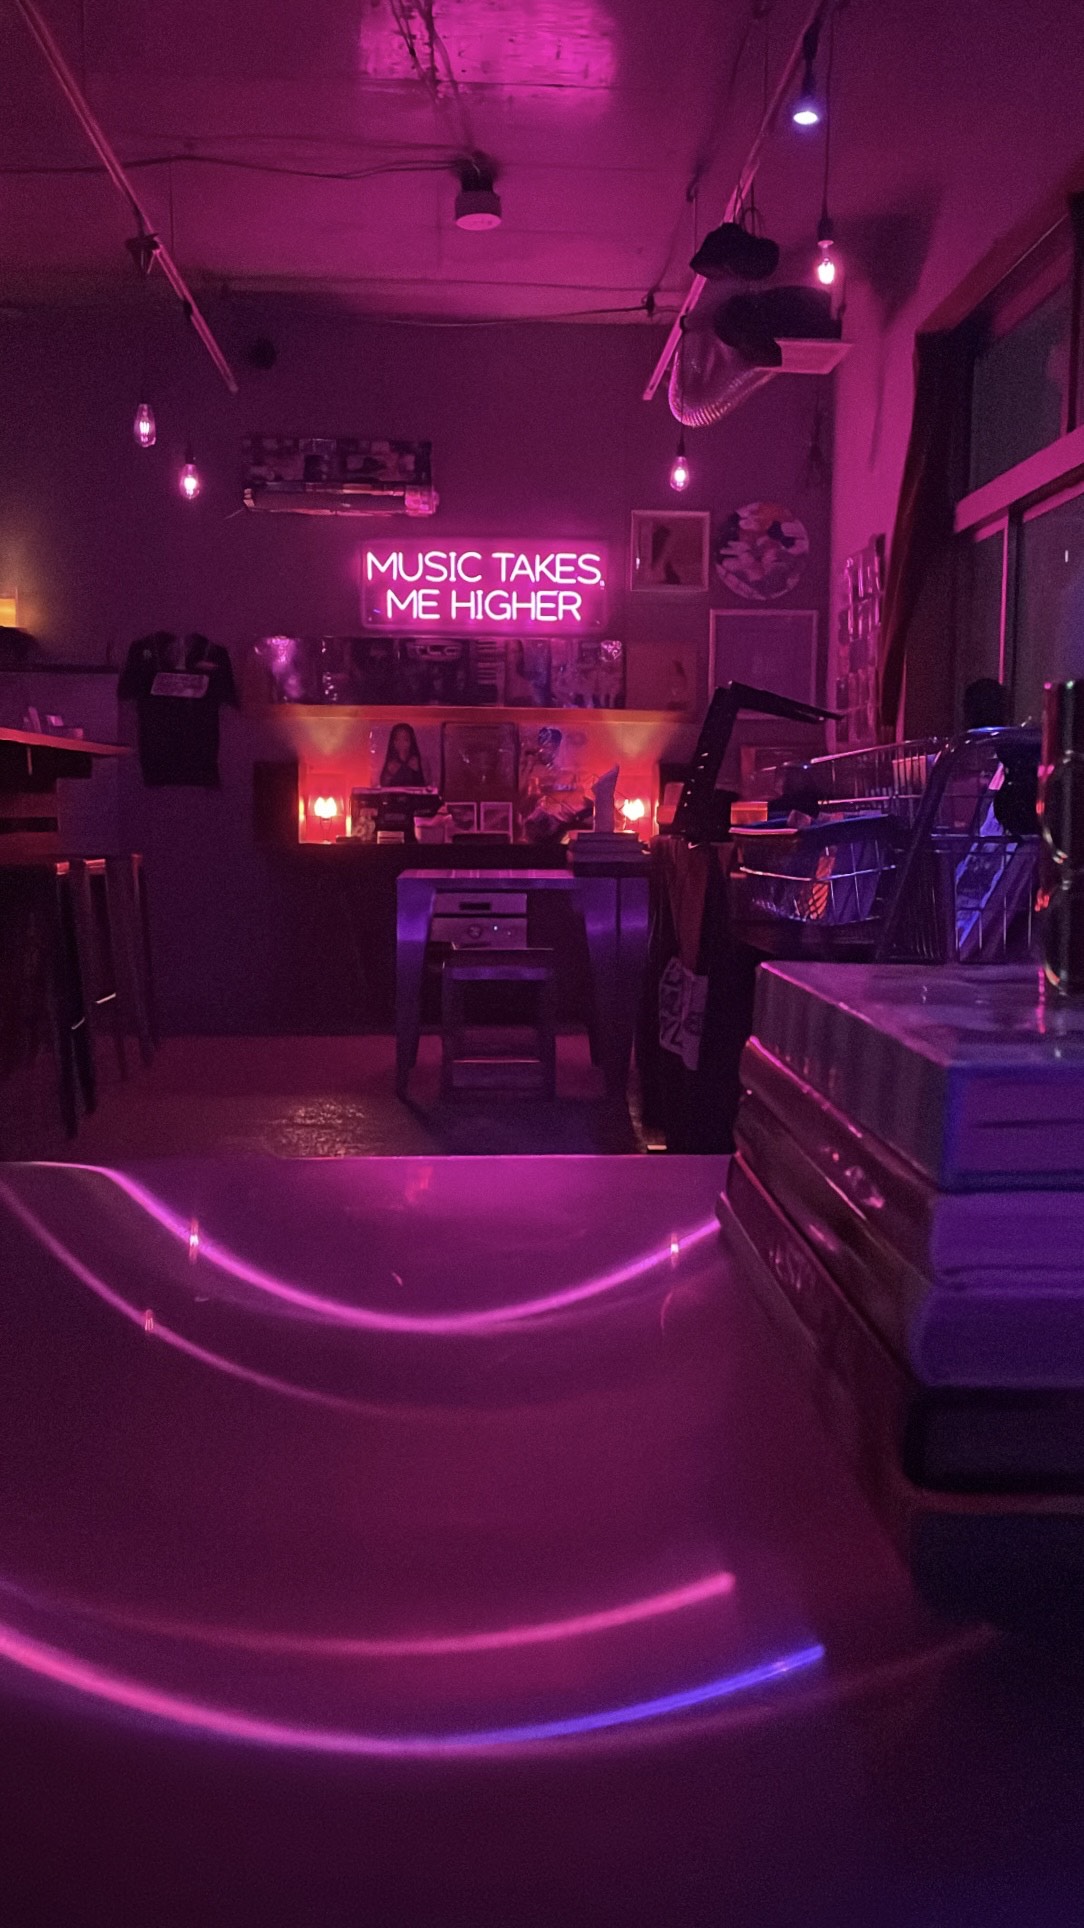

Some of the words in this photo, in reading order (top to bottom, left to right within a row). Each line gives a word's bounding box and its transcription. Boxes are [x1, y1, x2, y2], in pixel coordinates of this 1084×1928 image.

[365, 551, 482, 582] MUSIC
[491, 552, 602, 584] TAKES
[385, 588, 440, 619] ME
[450, 589, 583, 621] HIGHER
